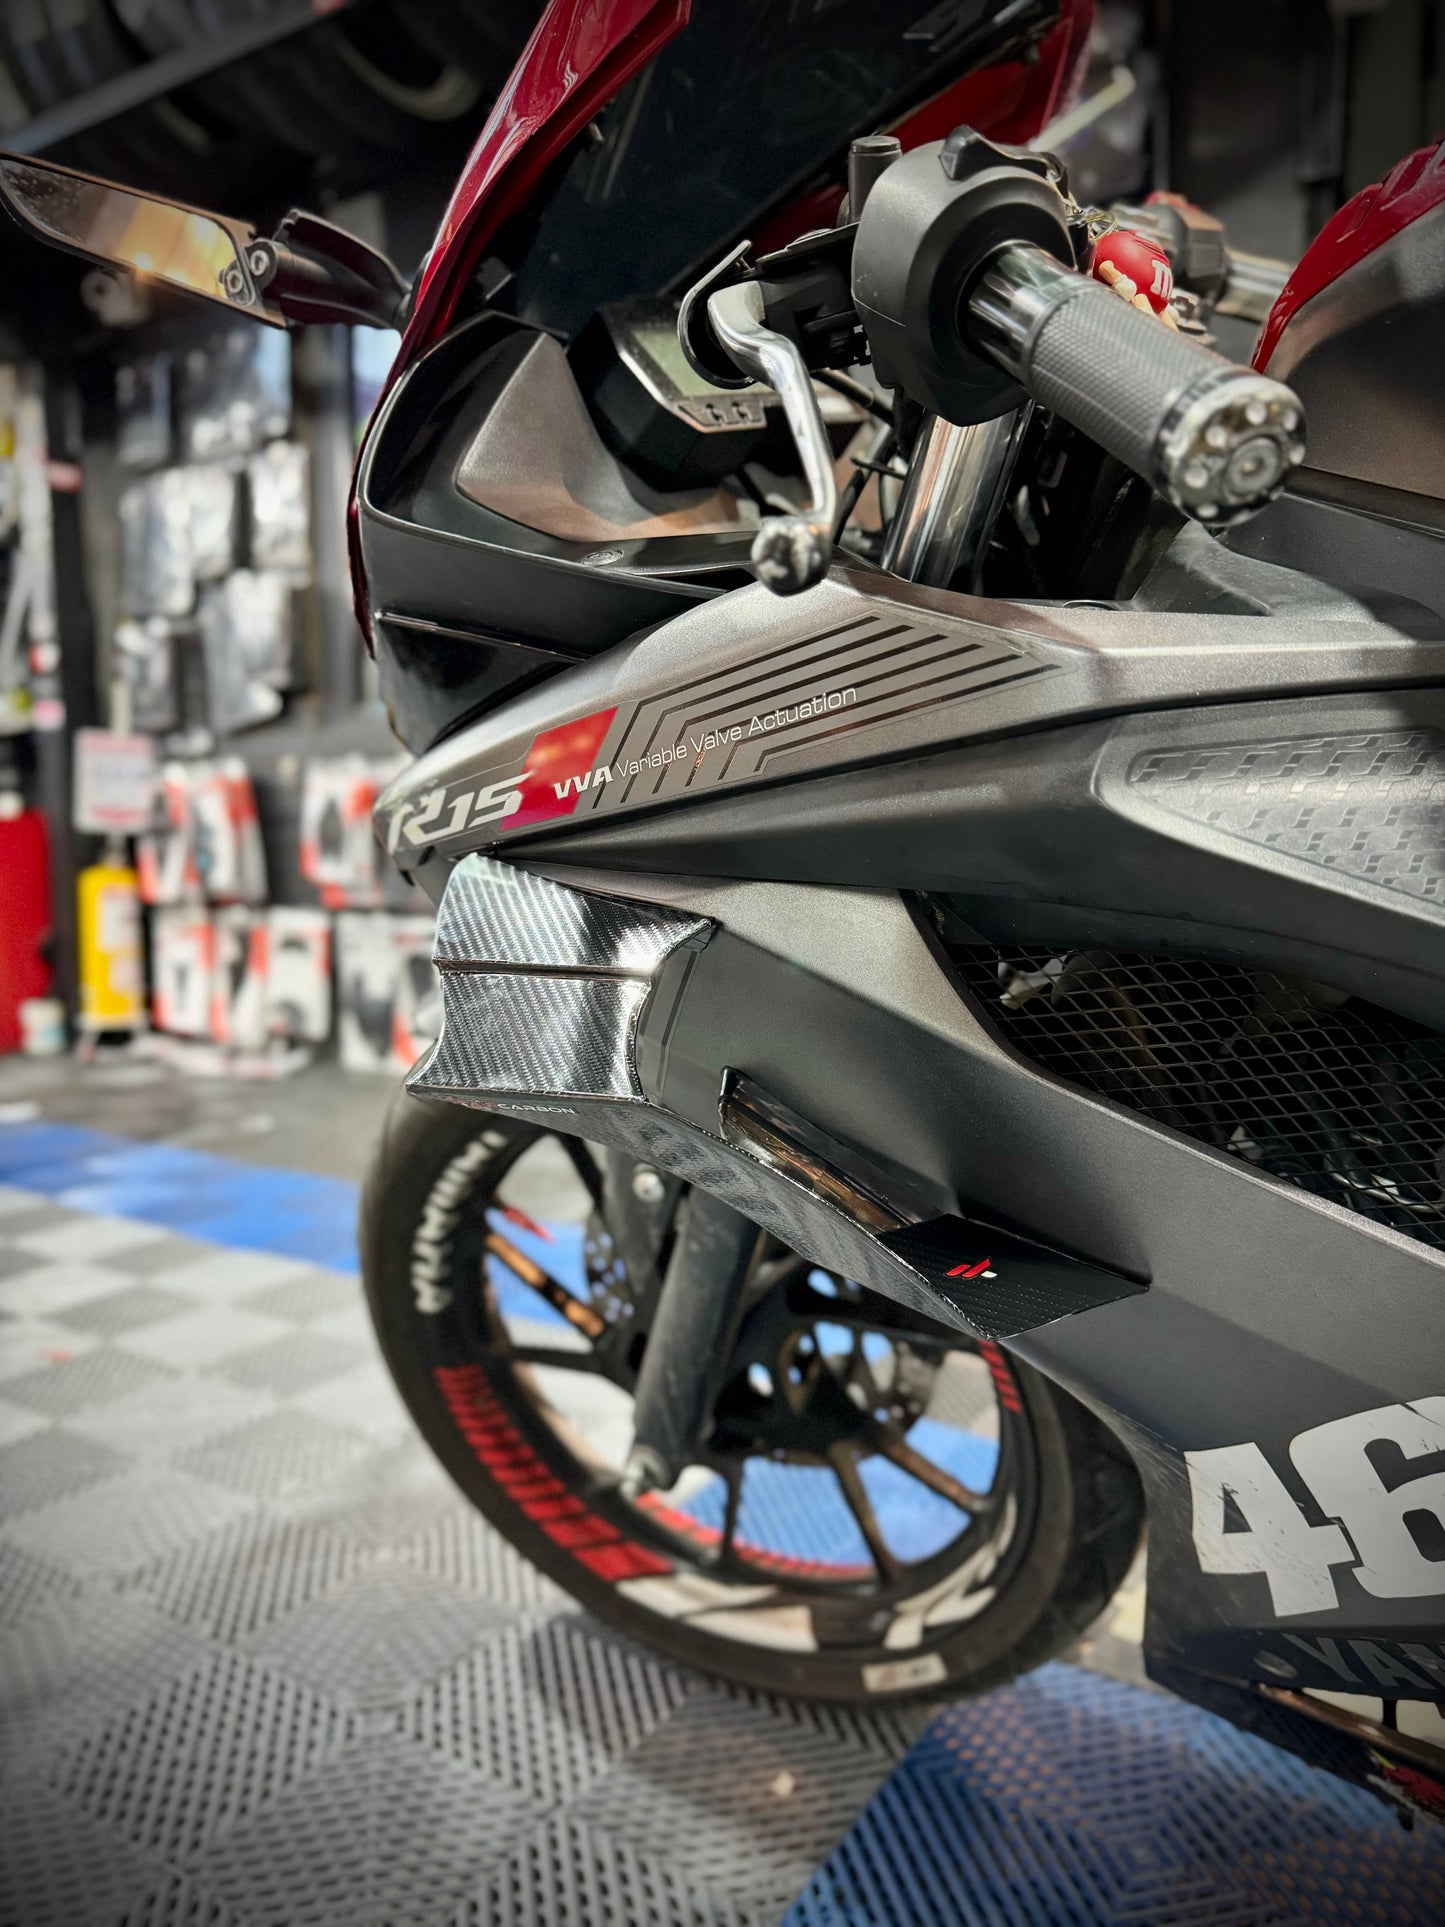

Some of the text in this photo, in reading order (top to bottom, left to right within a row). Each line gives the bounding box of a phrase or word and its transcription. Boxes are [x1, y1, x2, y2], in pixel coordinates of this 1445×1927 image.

[387, 687, 857, 856] R15 VVA Variable Valve Actuation
[498, 1103, 576, 1115] CARBON
[1184, 1396, 1445, 1617] 46
